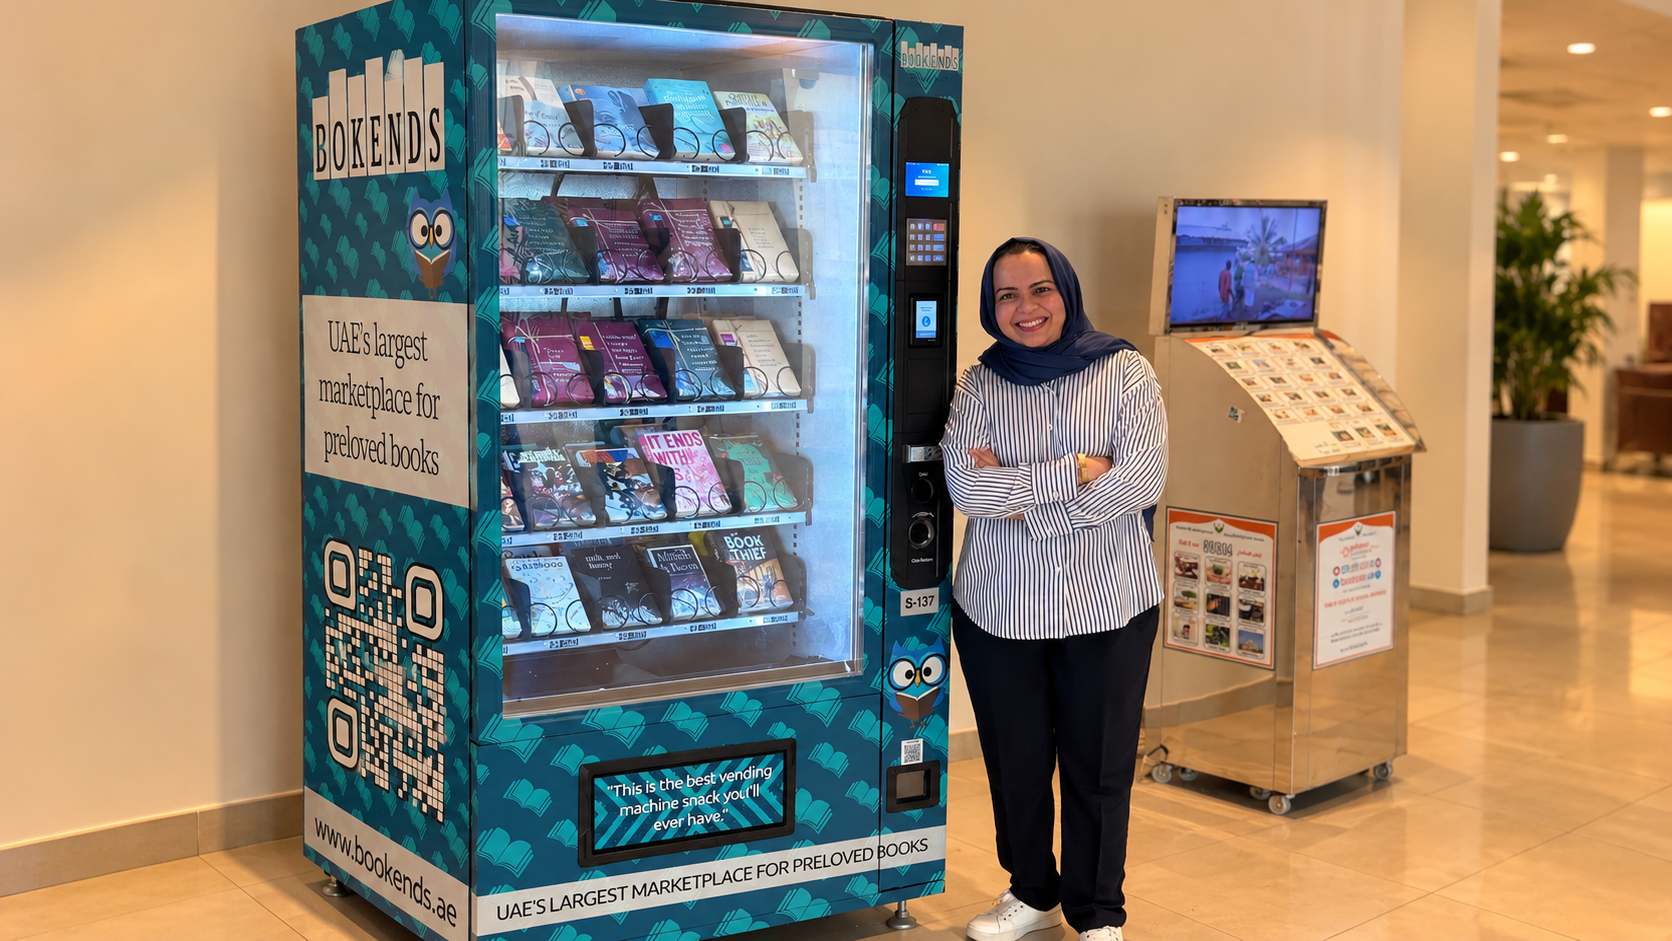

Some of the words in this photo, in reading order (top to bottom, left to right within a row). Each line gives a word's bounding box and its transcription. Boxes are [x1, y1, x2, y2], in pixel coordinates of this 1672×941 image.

[315, 107, 441, 173] BOKENDS
[328, 319, 371, 355] UAE's
[373, 321, 428, 369] largest
[319, 373, 412, 420] marketplace
[416, 382, 441, 420] for
[324, 425, 387, 463] preloved
[389, 433, 439, 476] books
[646, 434, 661, 449] IT
[663, 432, 703, 448] ENDS
[723, 535, 764, 549] BOOK
[729, 547, 767, 561] THIEF
[905, 595, 935, 609] S-137
[645, 780, 656, 793] is
[660, 778, 683, 791] the
[686, 774, 716, 788] best
[719, 765, 773, 783] vending
[619, 798, 679, 816] machine
[682, 790, 720, 807] snack
[653, 817, 684, 831] ever
[314, 817, 457, 928] www.bookends.ae
[497, 899, 546, 921] UAE'S
[550, 885, 628, 912] LARGEST
[632, 866, 753, 899] MARKETPLACE
[756, 861, 789, 879] FOR
[793, 847, 874, 873] PRELOVED
[877, 838, 928, 859] BOOKS
